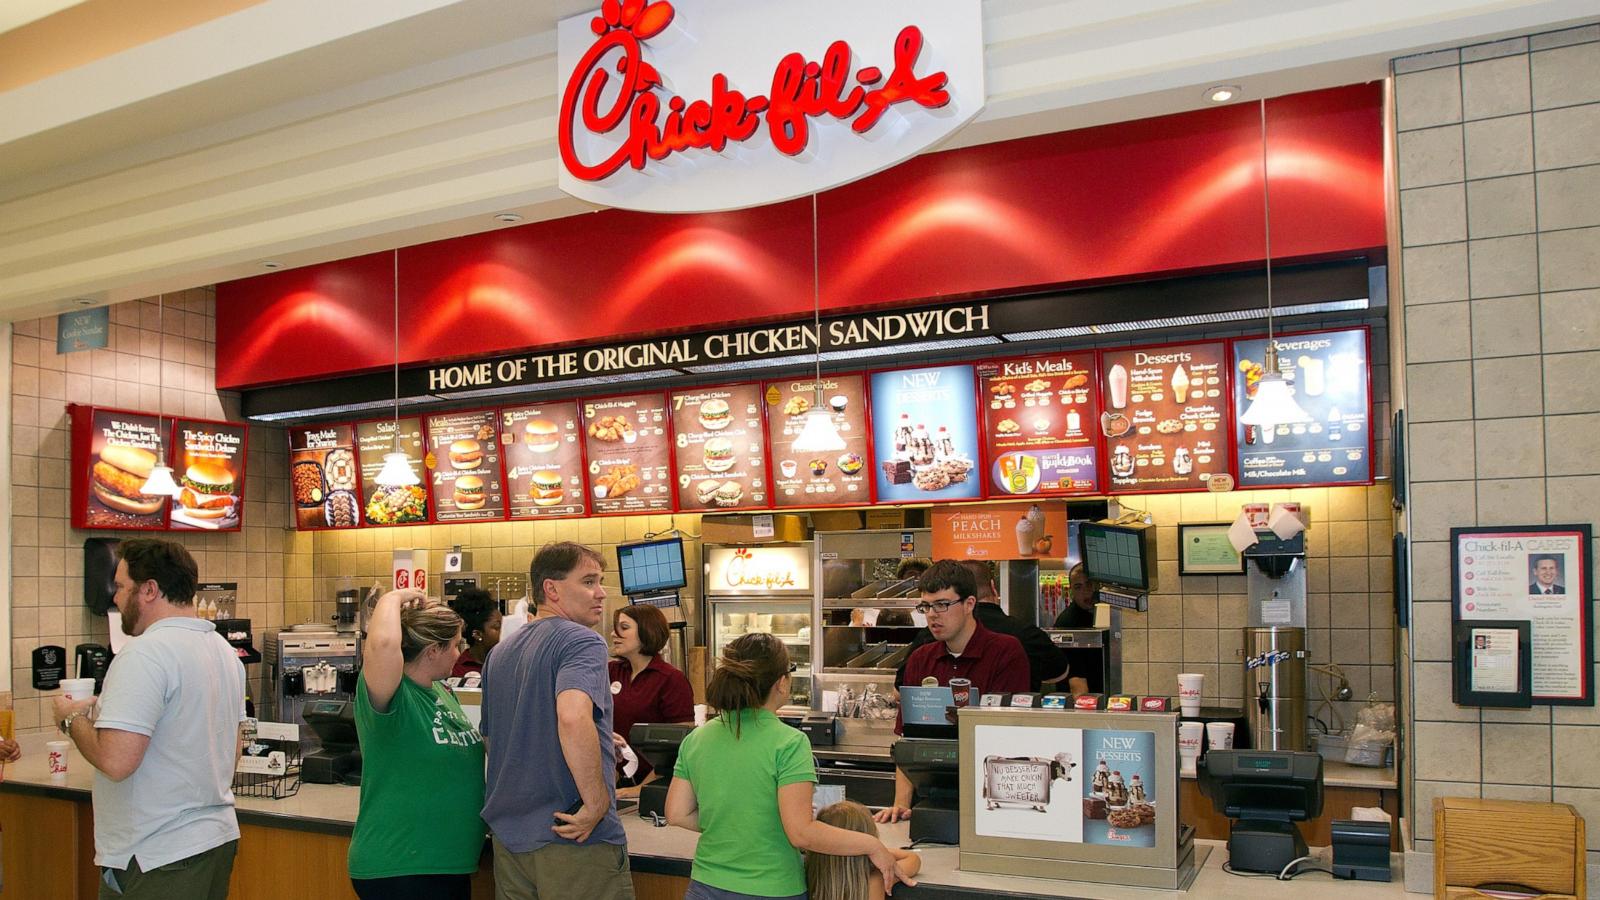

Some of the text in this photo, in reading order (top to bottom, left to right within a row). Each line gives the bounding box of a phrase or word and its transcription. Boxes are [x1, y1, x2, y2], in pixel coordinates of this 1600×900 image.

[559, 8, 950, 181] Chick-fil-A
[429, 304, 990, 390] HOME OF THE ORIGINAL CHICKEN SANDWICH
[1134, 352, 1191, 365] Desserts
[1003, 361, 1033, 376] Kid's
[1036, 358, 1073, 373] Meals
[902, 371, 941, 388] NEW
[673, 396, 684, 411] 7
[1184, 406, 1214, 414] Chocolate
[585, 404, 595, 418] 5
[504, 412, 513, 426] 3
[111, 421, 122, 431] We
[103, 428, 116, 439] The
[183, 430, 240, 445] The Spicy Chicken
[320, 429, 337, 440] Made
[107, 438, 131, 448] Chicken
[315, 439, 337, 449] Sharing
[432, 436, 438, 449] 1
[677, 433, 688, 448] 8
[215, 443, 237, 454] Deluxe
[1243, 455, 1267, 465] Coffee
[508, 467, 518, 480] 4
[590, 460, 600, 474] 6
[1243, 466, 1306, 478] Milk/Chocolate Milk
[434, 471, 442, 485] 2
[680, 474, 690, 488] 9
[1112, 476, 1138, 486] Toppings
[952, 519, 1001, 532] PEACH
[953, 531, 1001, 540] MILKSHAKES
[1464, 540, 1523, 552] Chick-fil-A
[1103, 736, 1136, 749] NEW
[1095, 750, 1142, 762] DESSERTS
[1001, 774, 1019, 782] MAKE
[997, 783, 1036, 791] THAT MUCH
[1006, 792, 1040, 802] SWEETER
